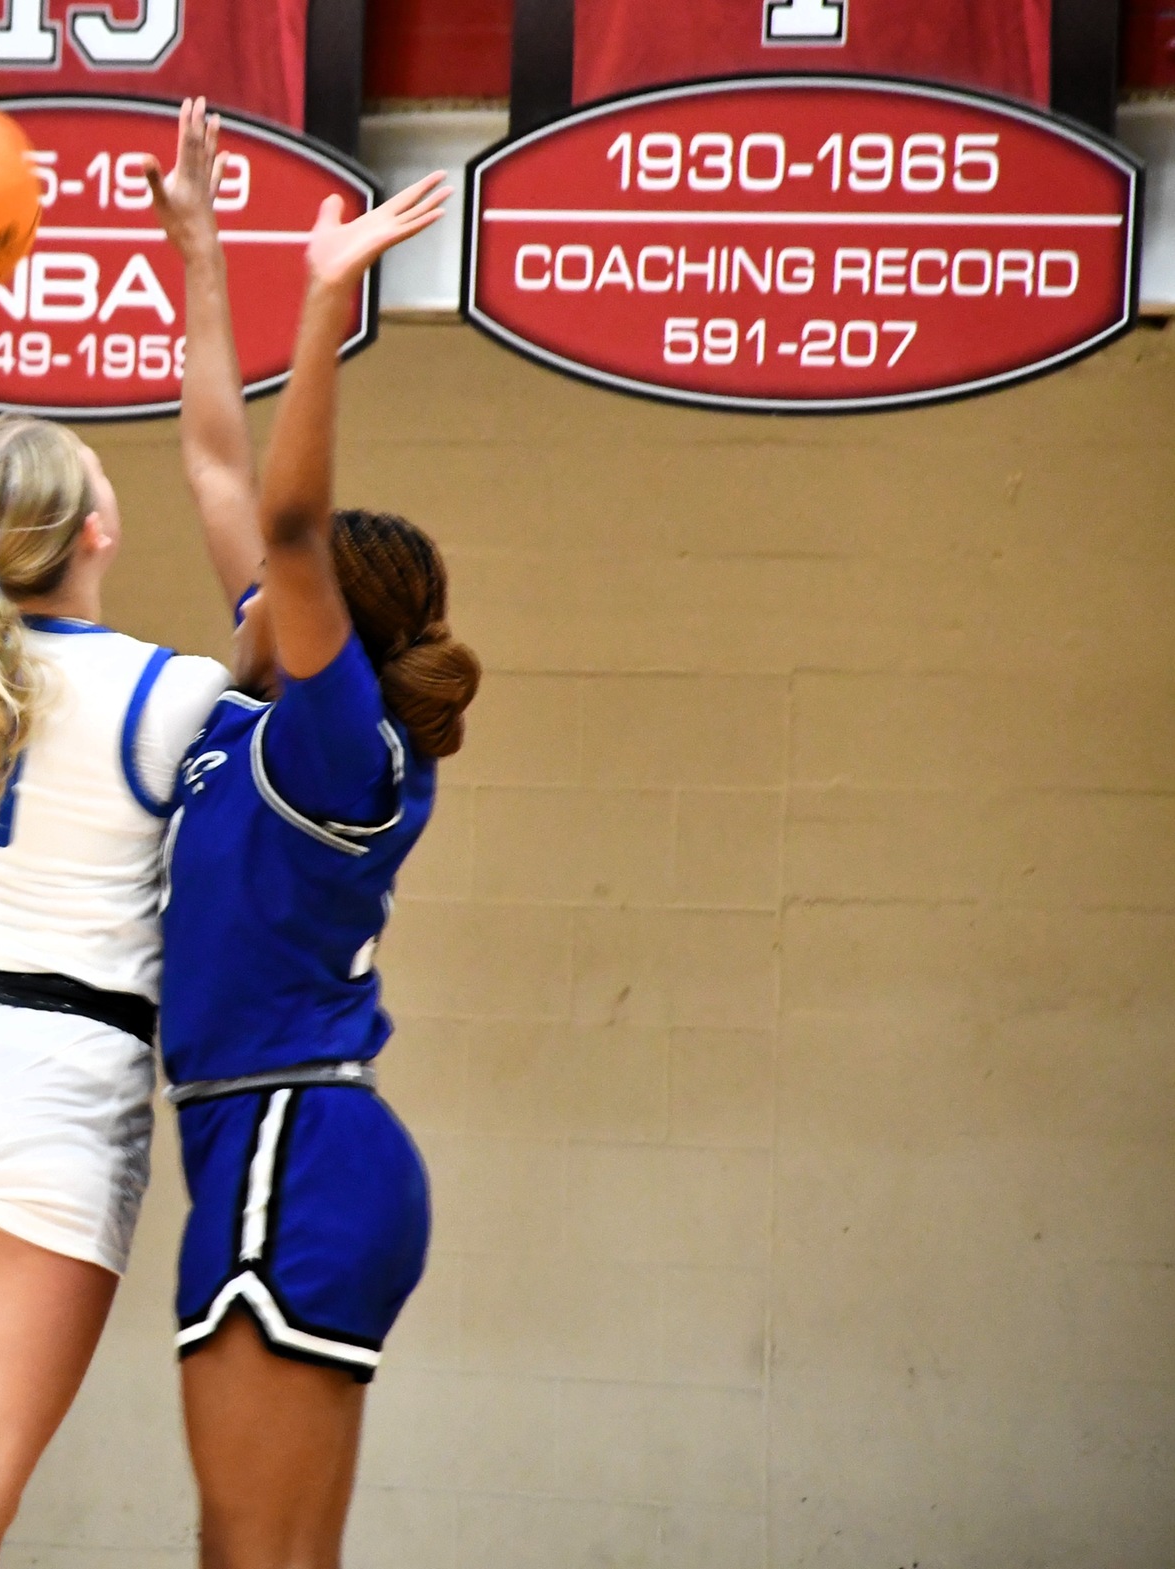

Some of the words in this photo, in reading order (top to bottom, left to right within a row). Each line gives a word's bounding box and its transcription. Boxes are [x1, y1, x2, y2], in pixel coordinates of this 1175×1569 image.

[606, 131, 1000, 193] 1930-1965
[514, 243, 816, 295] COACHING
[833, 247, 1080, 298] RECORD
[662, 316, 918, 368] 591-207
